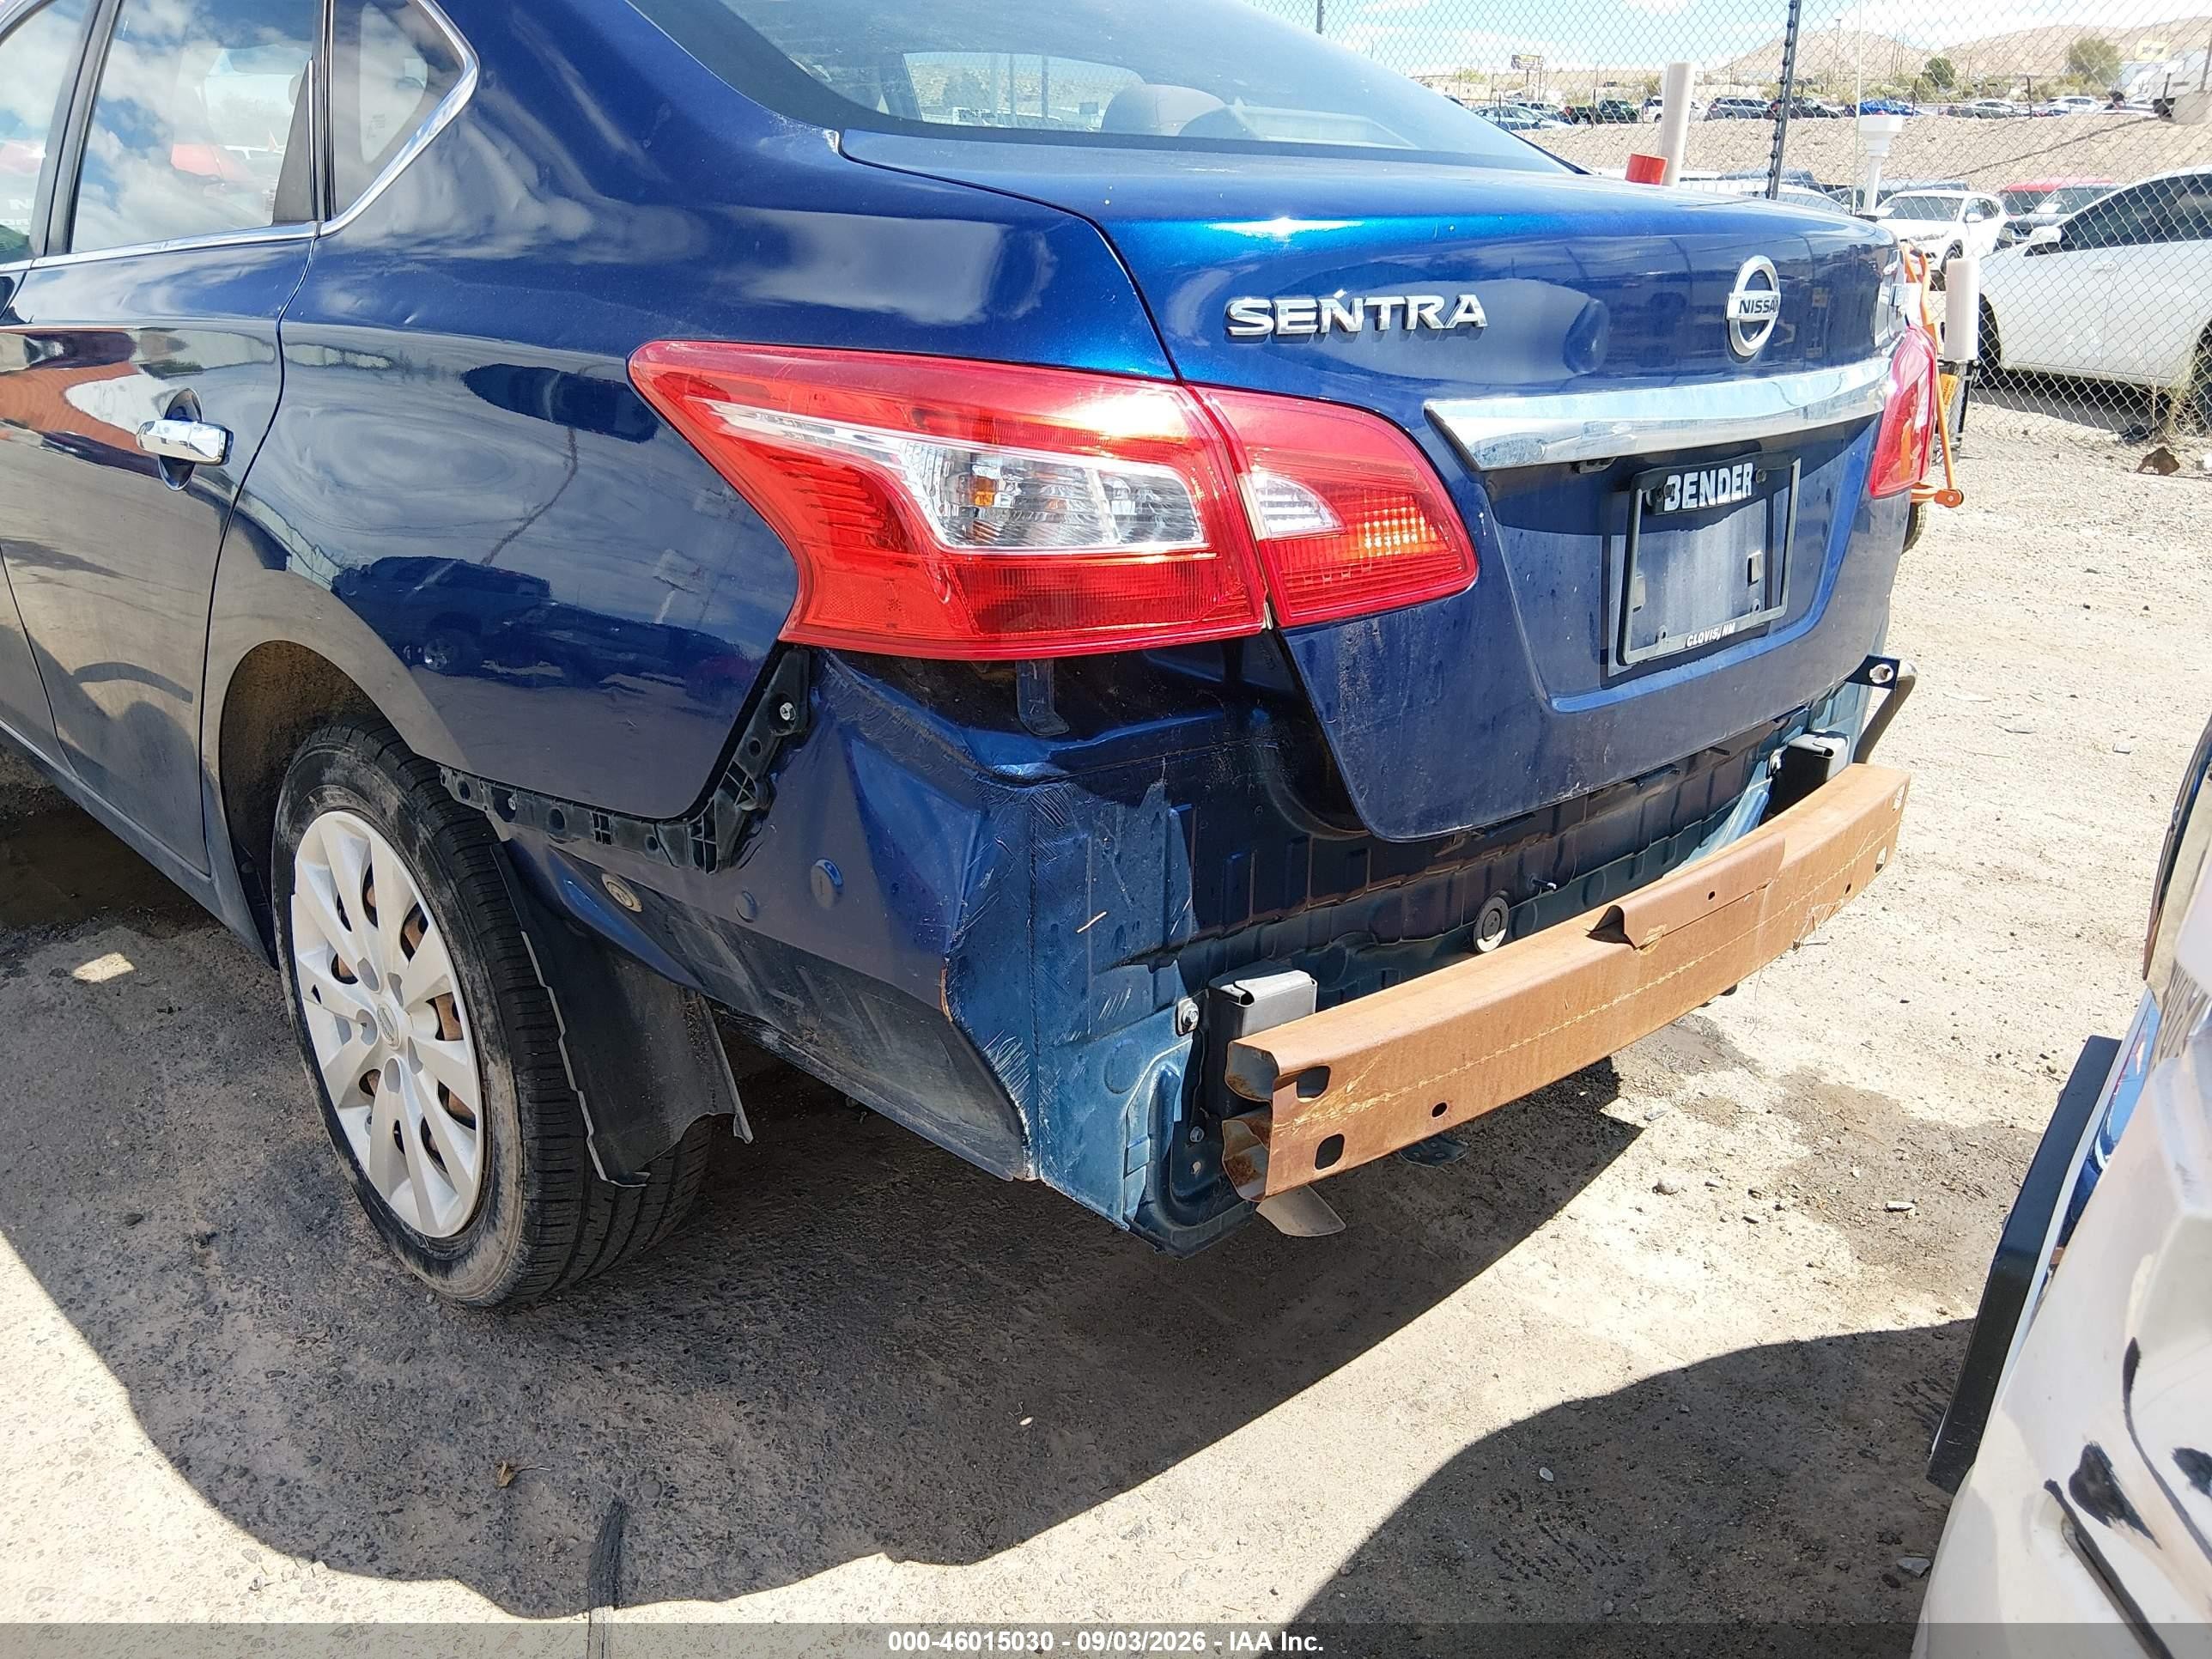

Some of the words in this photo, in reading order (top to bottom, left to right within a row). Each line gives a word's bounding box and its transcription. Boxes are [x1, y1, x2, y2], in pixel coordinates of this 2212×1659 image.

[1227, 294, 1488, 337] SENTRA
[1738, 299, 1779, 314] NISSAN
[1663, 462, 1754, 511] BENDER
